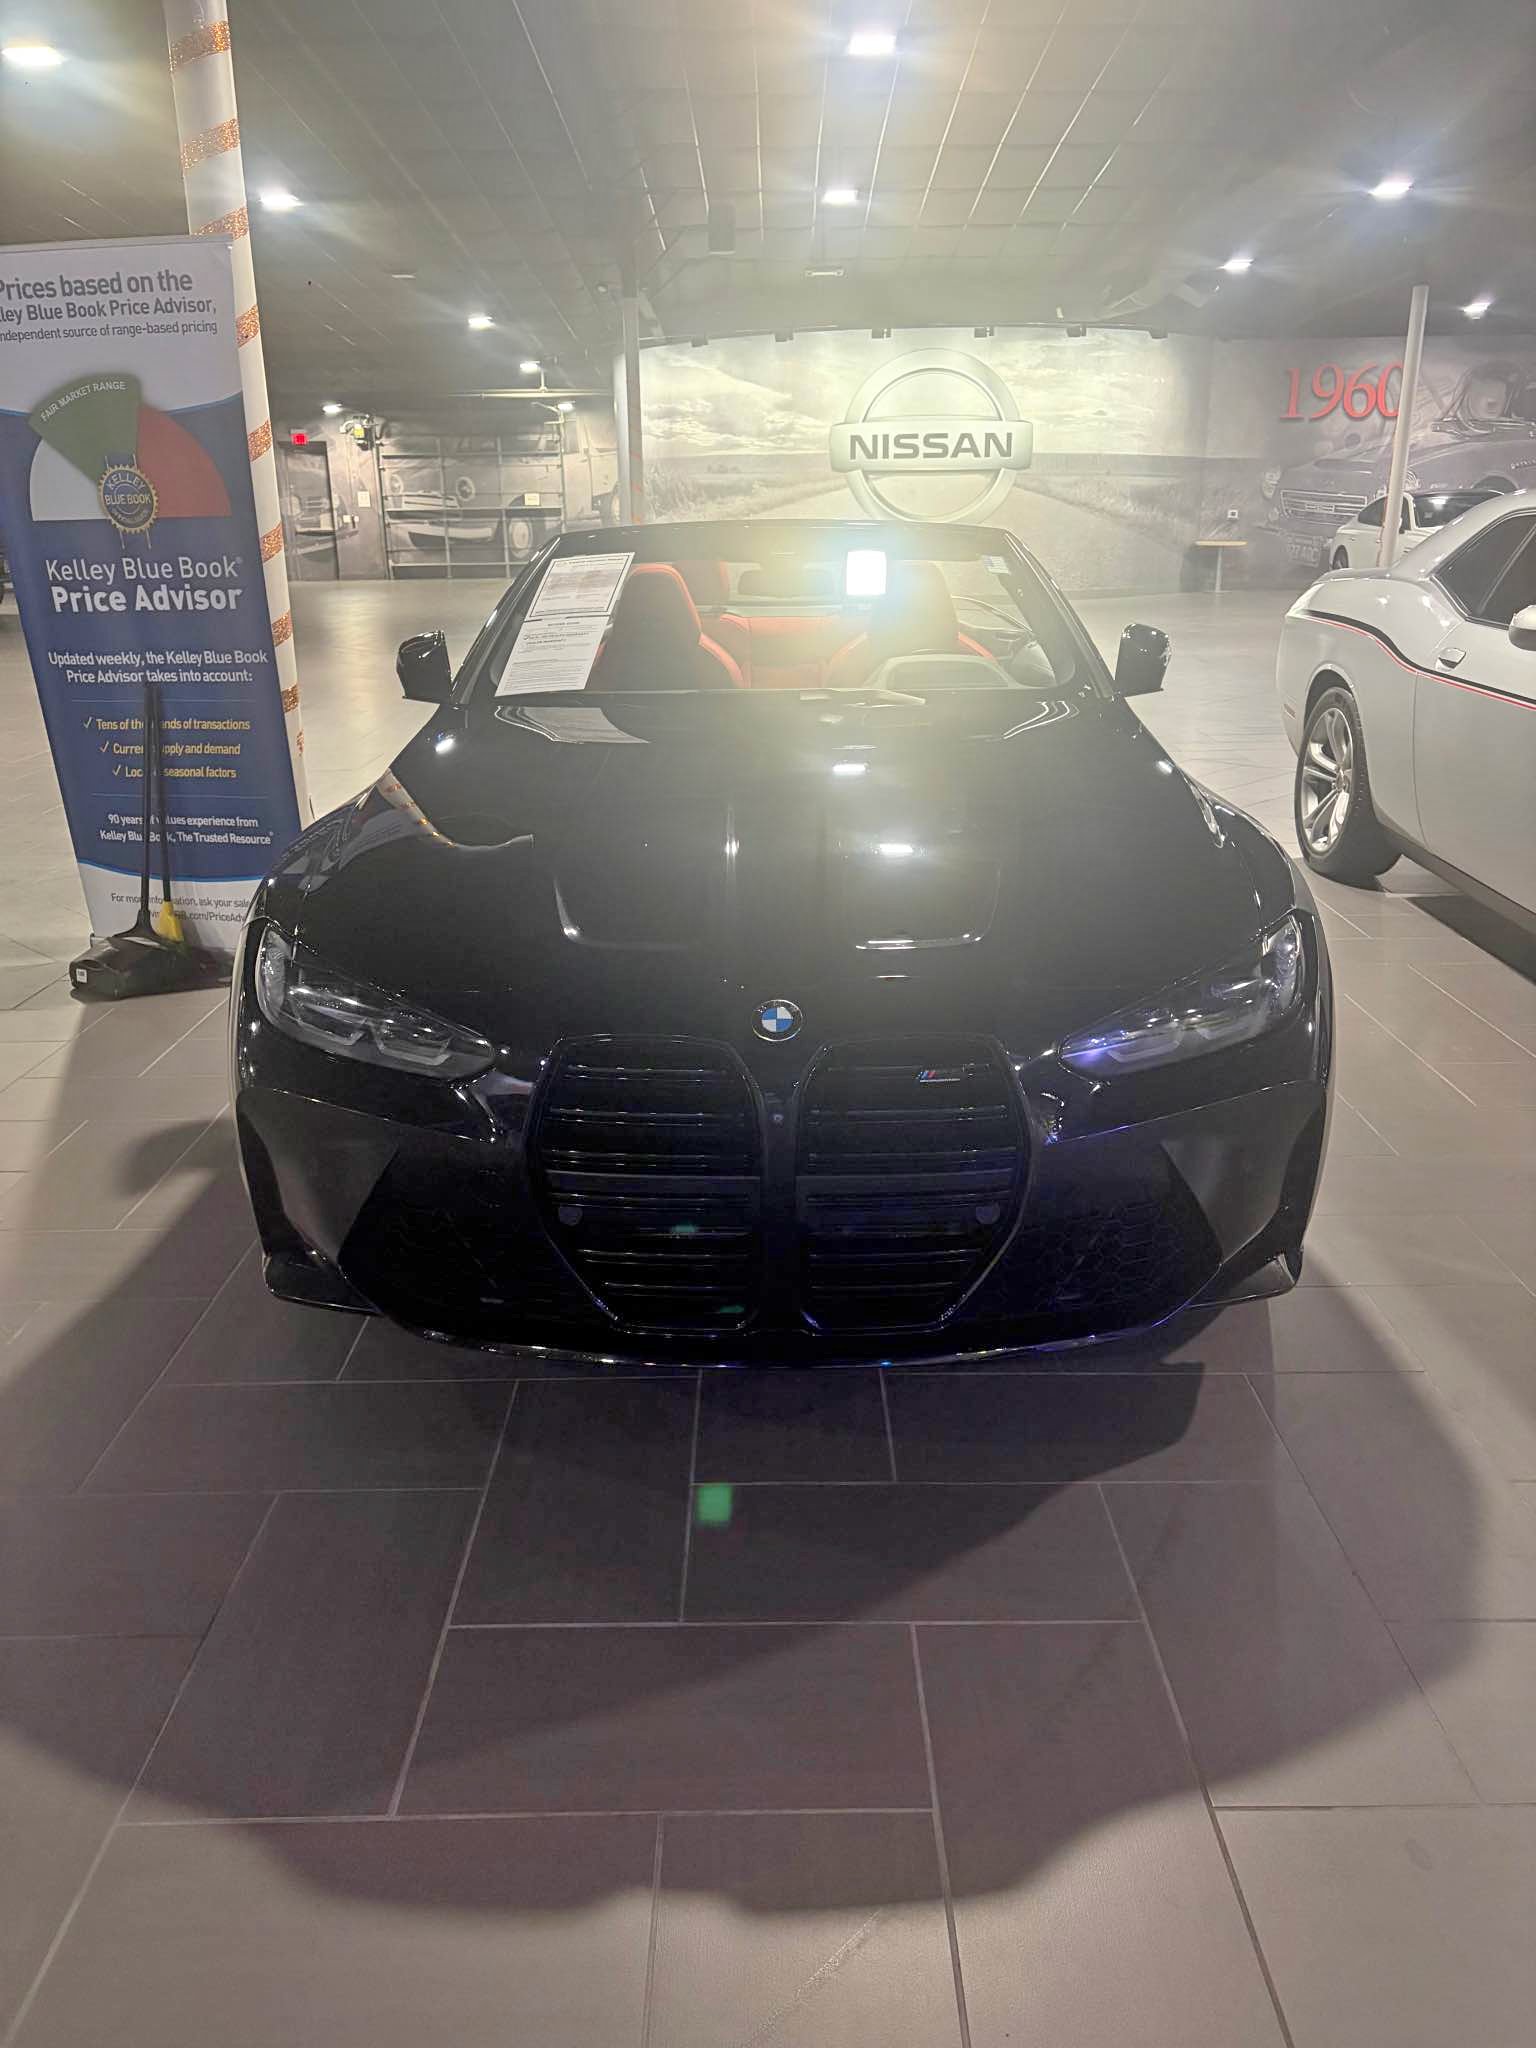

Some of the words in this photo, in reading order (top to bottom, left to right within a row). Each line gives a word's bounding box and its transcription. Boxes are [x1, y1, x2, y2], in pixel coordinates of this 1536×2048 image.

[59, 271, 122, 297] based
[127, 275, 154, 293] on
[157, 269, 192, 292] the
[26, 304, 63, 321] Blue
[65, 300, 107, 318] Book
[109, 298, 150, 316] Price
[153, 296, 216, 315] Advisor,
[62, 327, 98, 338] source
[99, 323, 110, 336] of
[112, 321, 179, 338] range-based
[181, 320, 217, 336] pricing
[1279, 362, 1403, 421] 1960
[40, 402, 59, 422] FAIR
[57, 384, 91, 408] MARKET
[92, 381, 127, 392] RANGE
[849, 432, 1013, 460] NISSAN
[106, 472, 146, 490] KELLEY
[104, 494, 126, 505] BLUE
[127, 494, 151, 505] BOOK
[45, 558, 115, 585] Kelley
[121, 557, 173, 579] Blue
[51, 585, 127, 613] Price
[135, 581, 242, 611] Advisor
[48, 651, 94, 668] Updated
[95, 651, 145, 667] weekly,
[146, 650, 164, 664] the
[166, 651, 202, 667] Kelley
[203, 650, 232, 664] Blue
[234, 649, 268, 663] Book
[66, 670, 95, 683] Price
[97, 669, 144, 683] Advisor
[146, 669, 178, 682] takes
[179, 669, 201, 682] into
[203, 669, 253, 682] account:
[96, 718, 118, 730] Tens
[119, 718, 130, 729] of
[183, 718, 193, 729] of
[193, 718, 250, 729] transactions
[185, 742, 203, 754] and
[204, 742, 240, 754] demand
[163, 766, 205, 777] seasonal
[206, 766, 237, 777] factors
[107, 814, 120, 824] 90
[187, 816, 235, 829] experience
[236, 816, 258, 828] from
[100, 830, 127, 844] Kelley
[176, 831, 193, 841] The
[193, 832, 228, 843] Trusted
[111, 892, 124, 902] For
[214, 898, 232, 909] your
